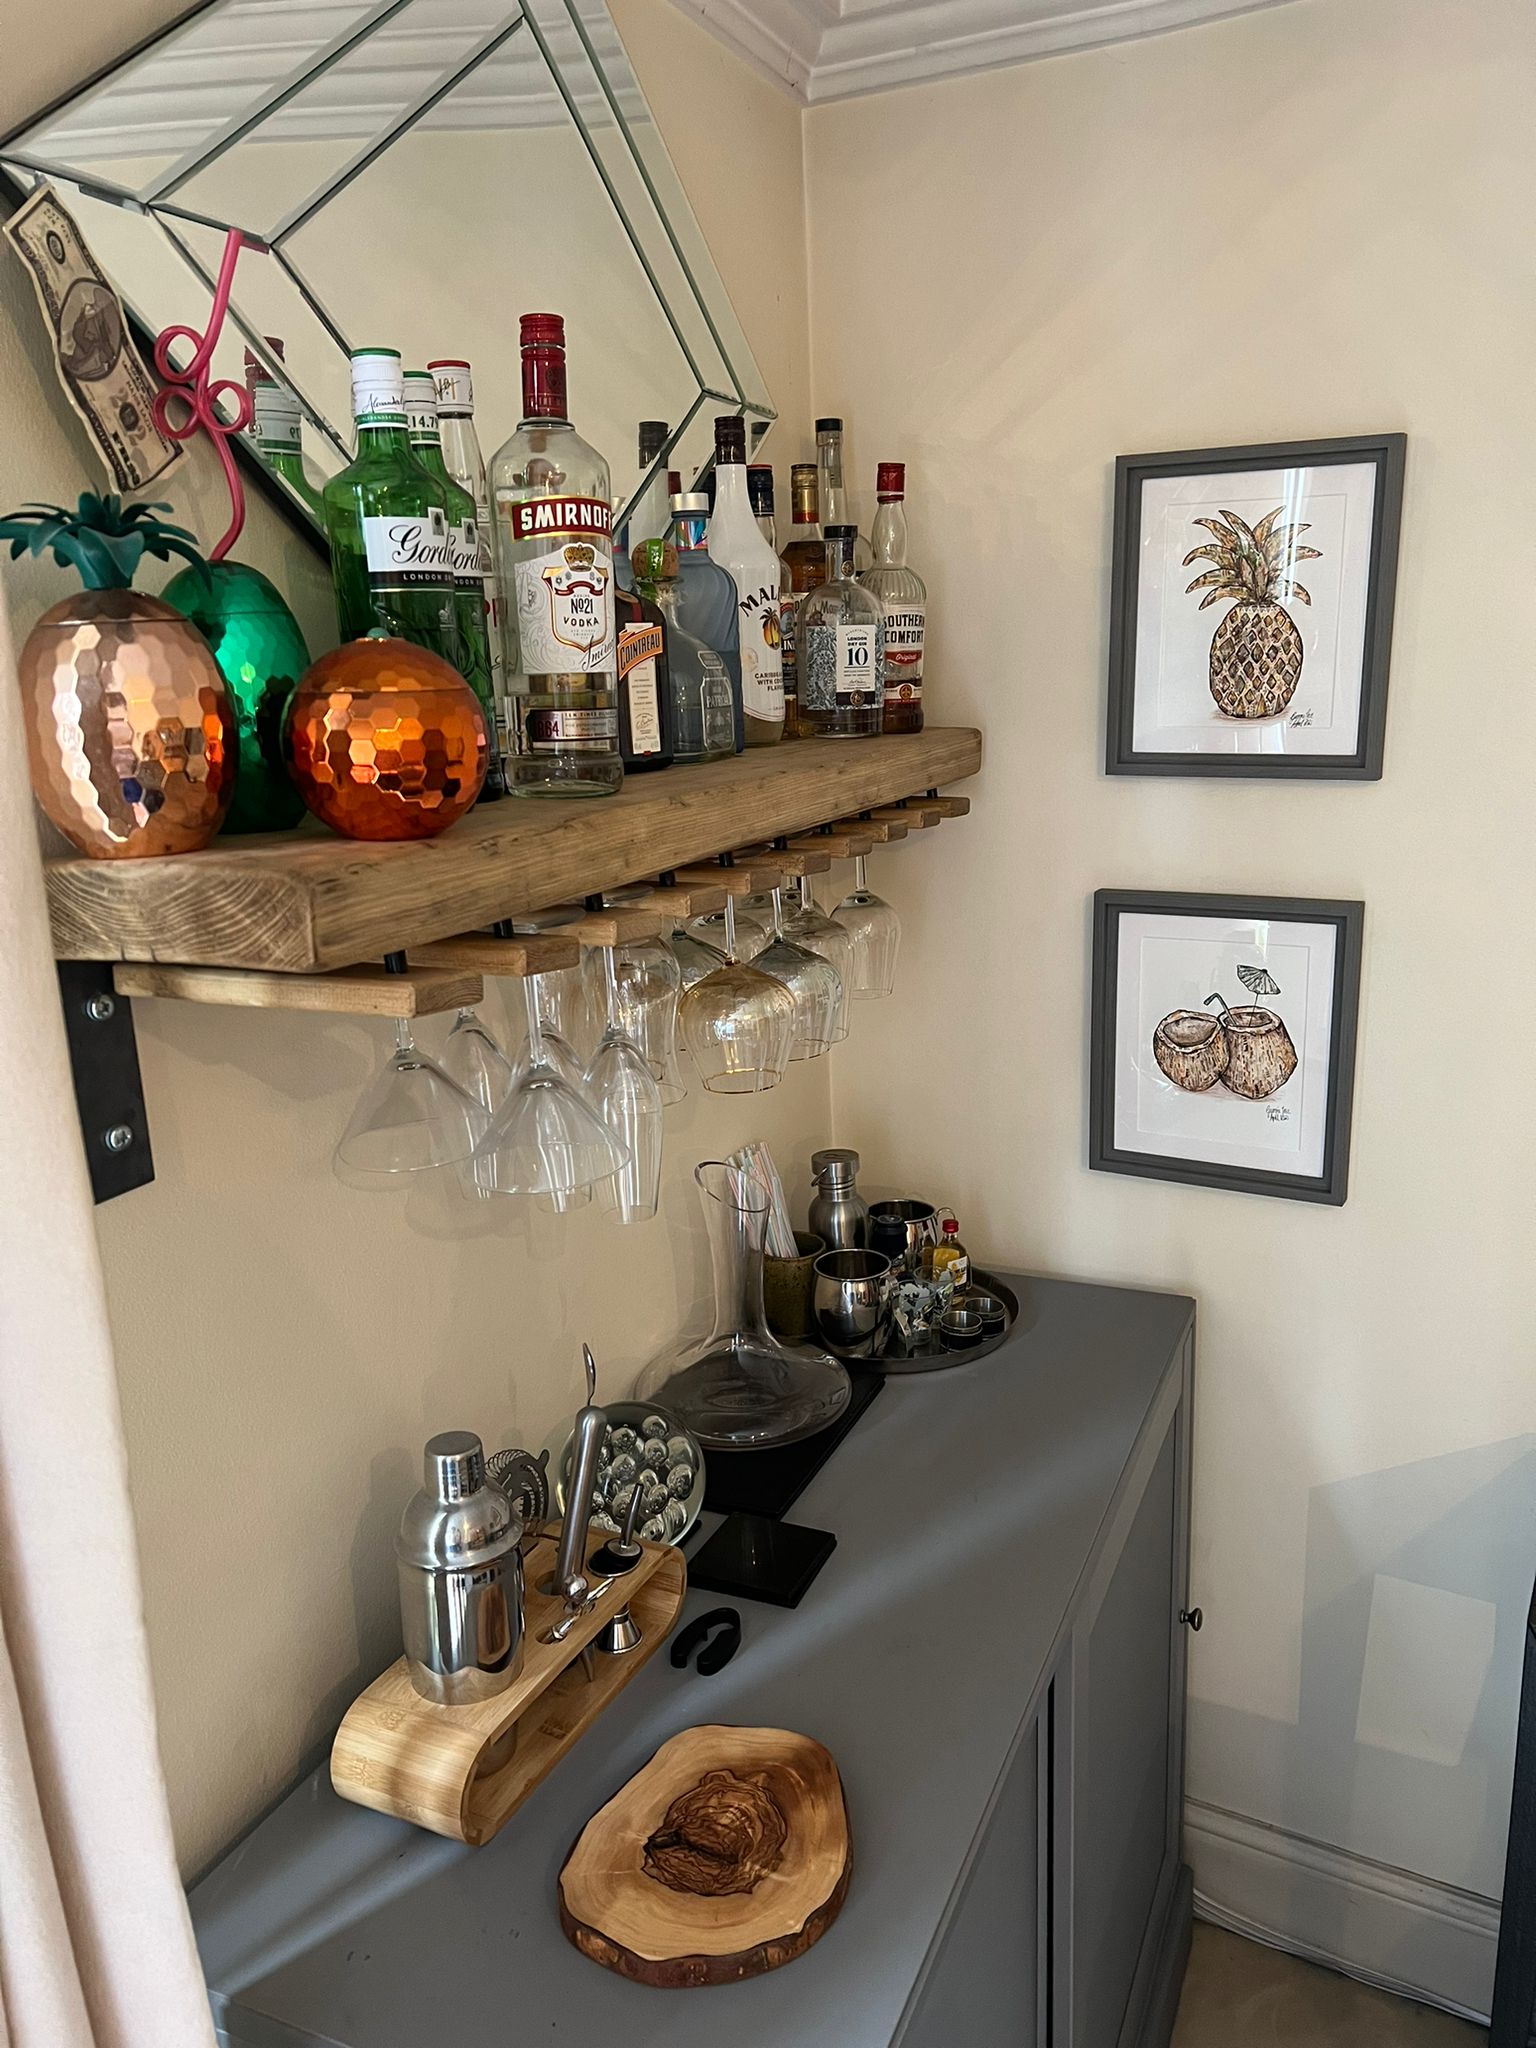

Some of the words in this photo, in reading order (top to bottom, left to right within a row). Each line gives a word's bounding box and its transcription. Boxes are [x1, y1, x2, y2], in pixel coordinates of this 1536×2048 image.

[563, 616, 600, 627] VODKA
[884, 630, 924, 643] COMFORT
[620, 632, 661, 671] COINTREAU
[847, 647, 869, 666] 10
